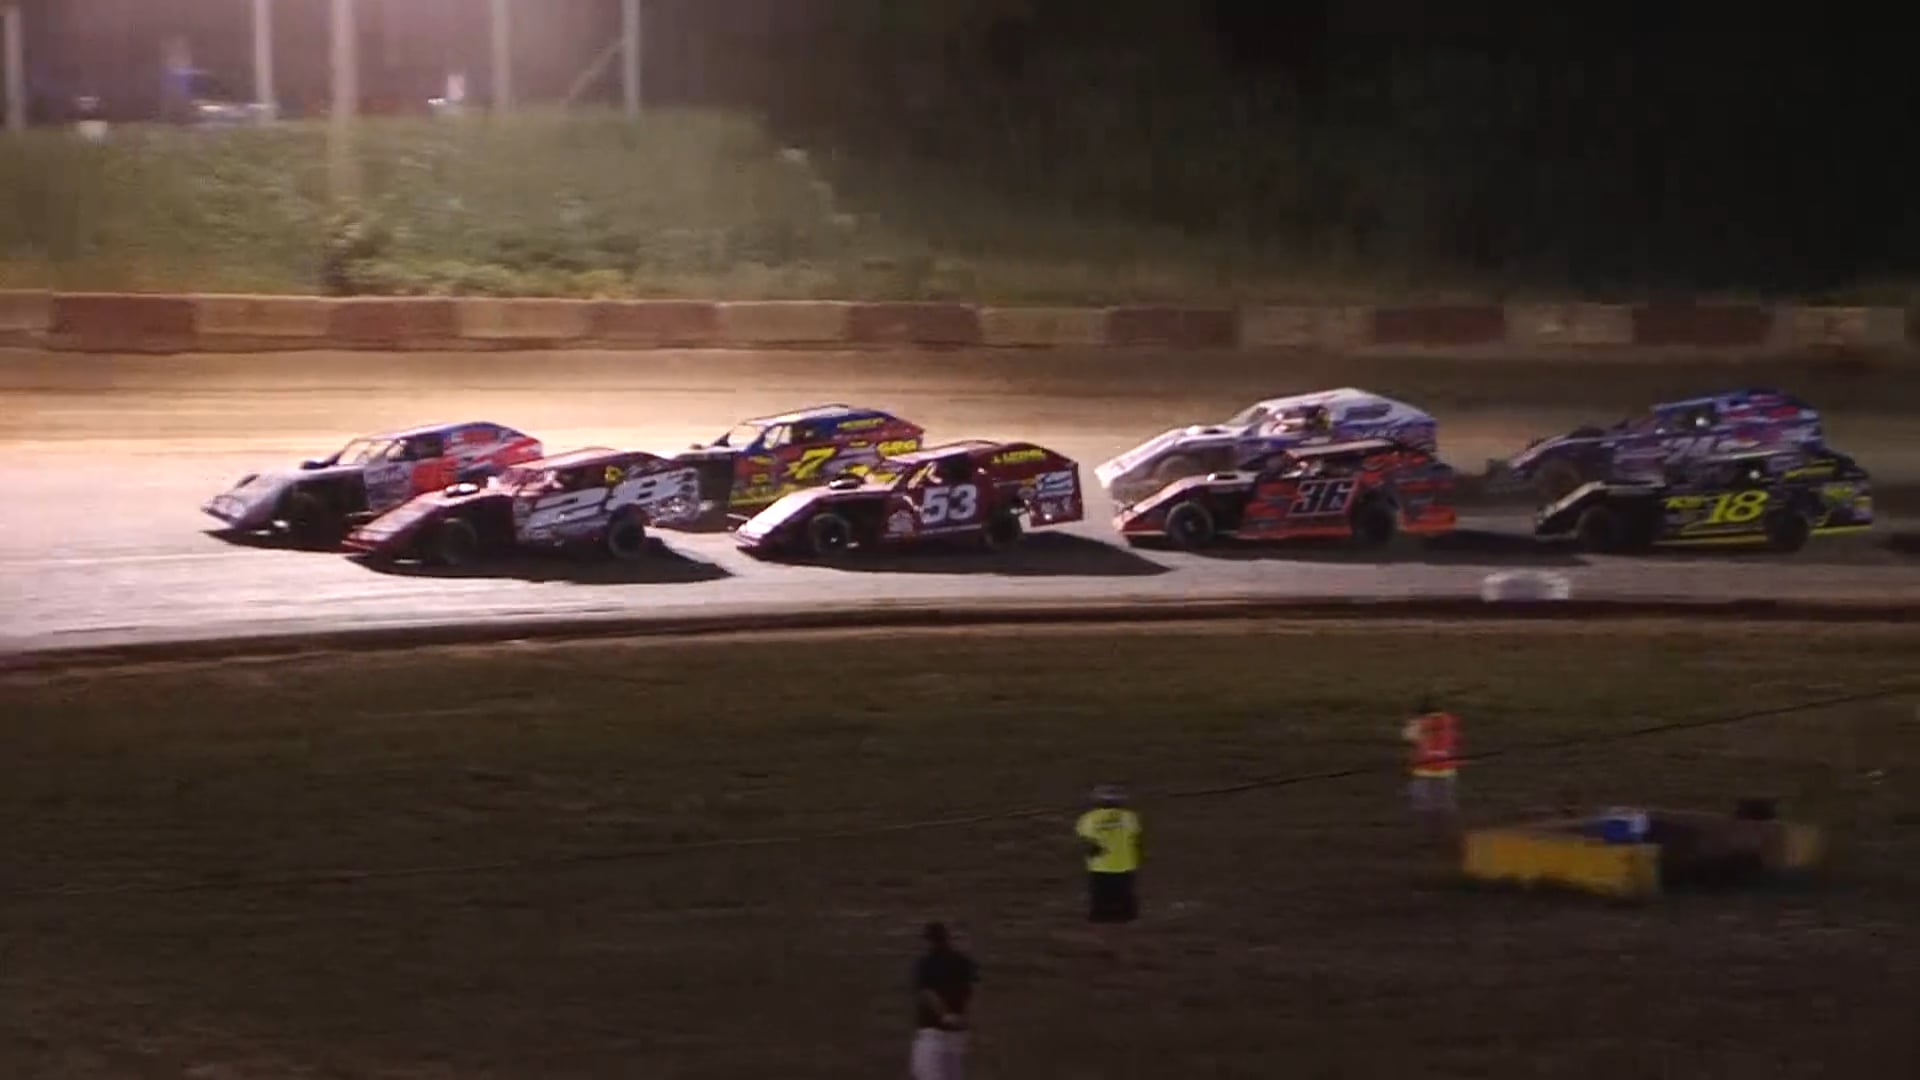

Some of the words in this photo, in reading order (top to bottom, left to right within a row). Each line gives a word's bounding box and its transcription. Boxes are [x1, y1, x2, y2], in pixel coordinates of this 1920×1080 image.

[920, 484, 977, 524] 53
[1290, 478, 1358, 517] 36
[1710, 490, 1769, 522] 18
